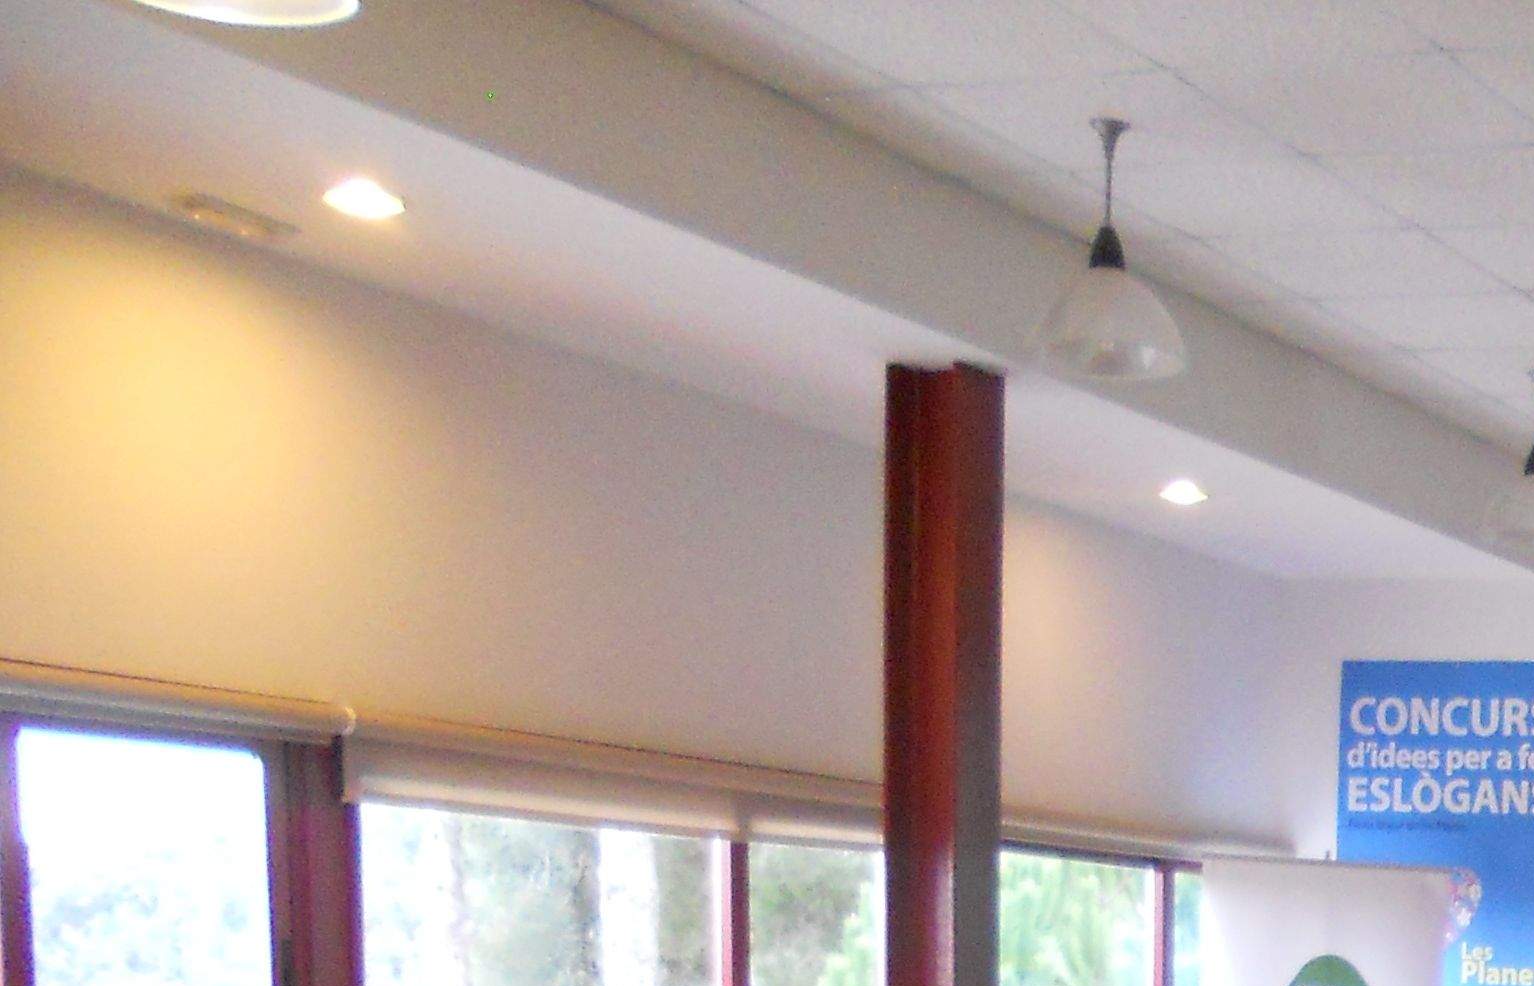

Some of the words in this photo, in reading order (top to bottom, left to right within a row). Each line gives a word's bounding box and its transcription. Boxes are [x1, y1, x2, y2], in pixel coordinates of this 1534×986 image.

[1347, 741, 1440, 771] d'idees
[1446, 748, 1492, 776] per
[1496, 752, 1512, 771] a
[1461, 942, 1493, 961] Les
